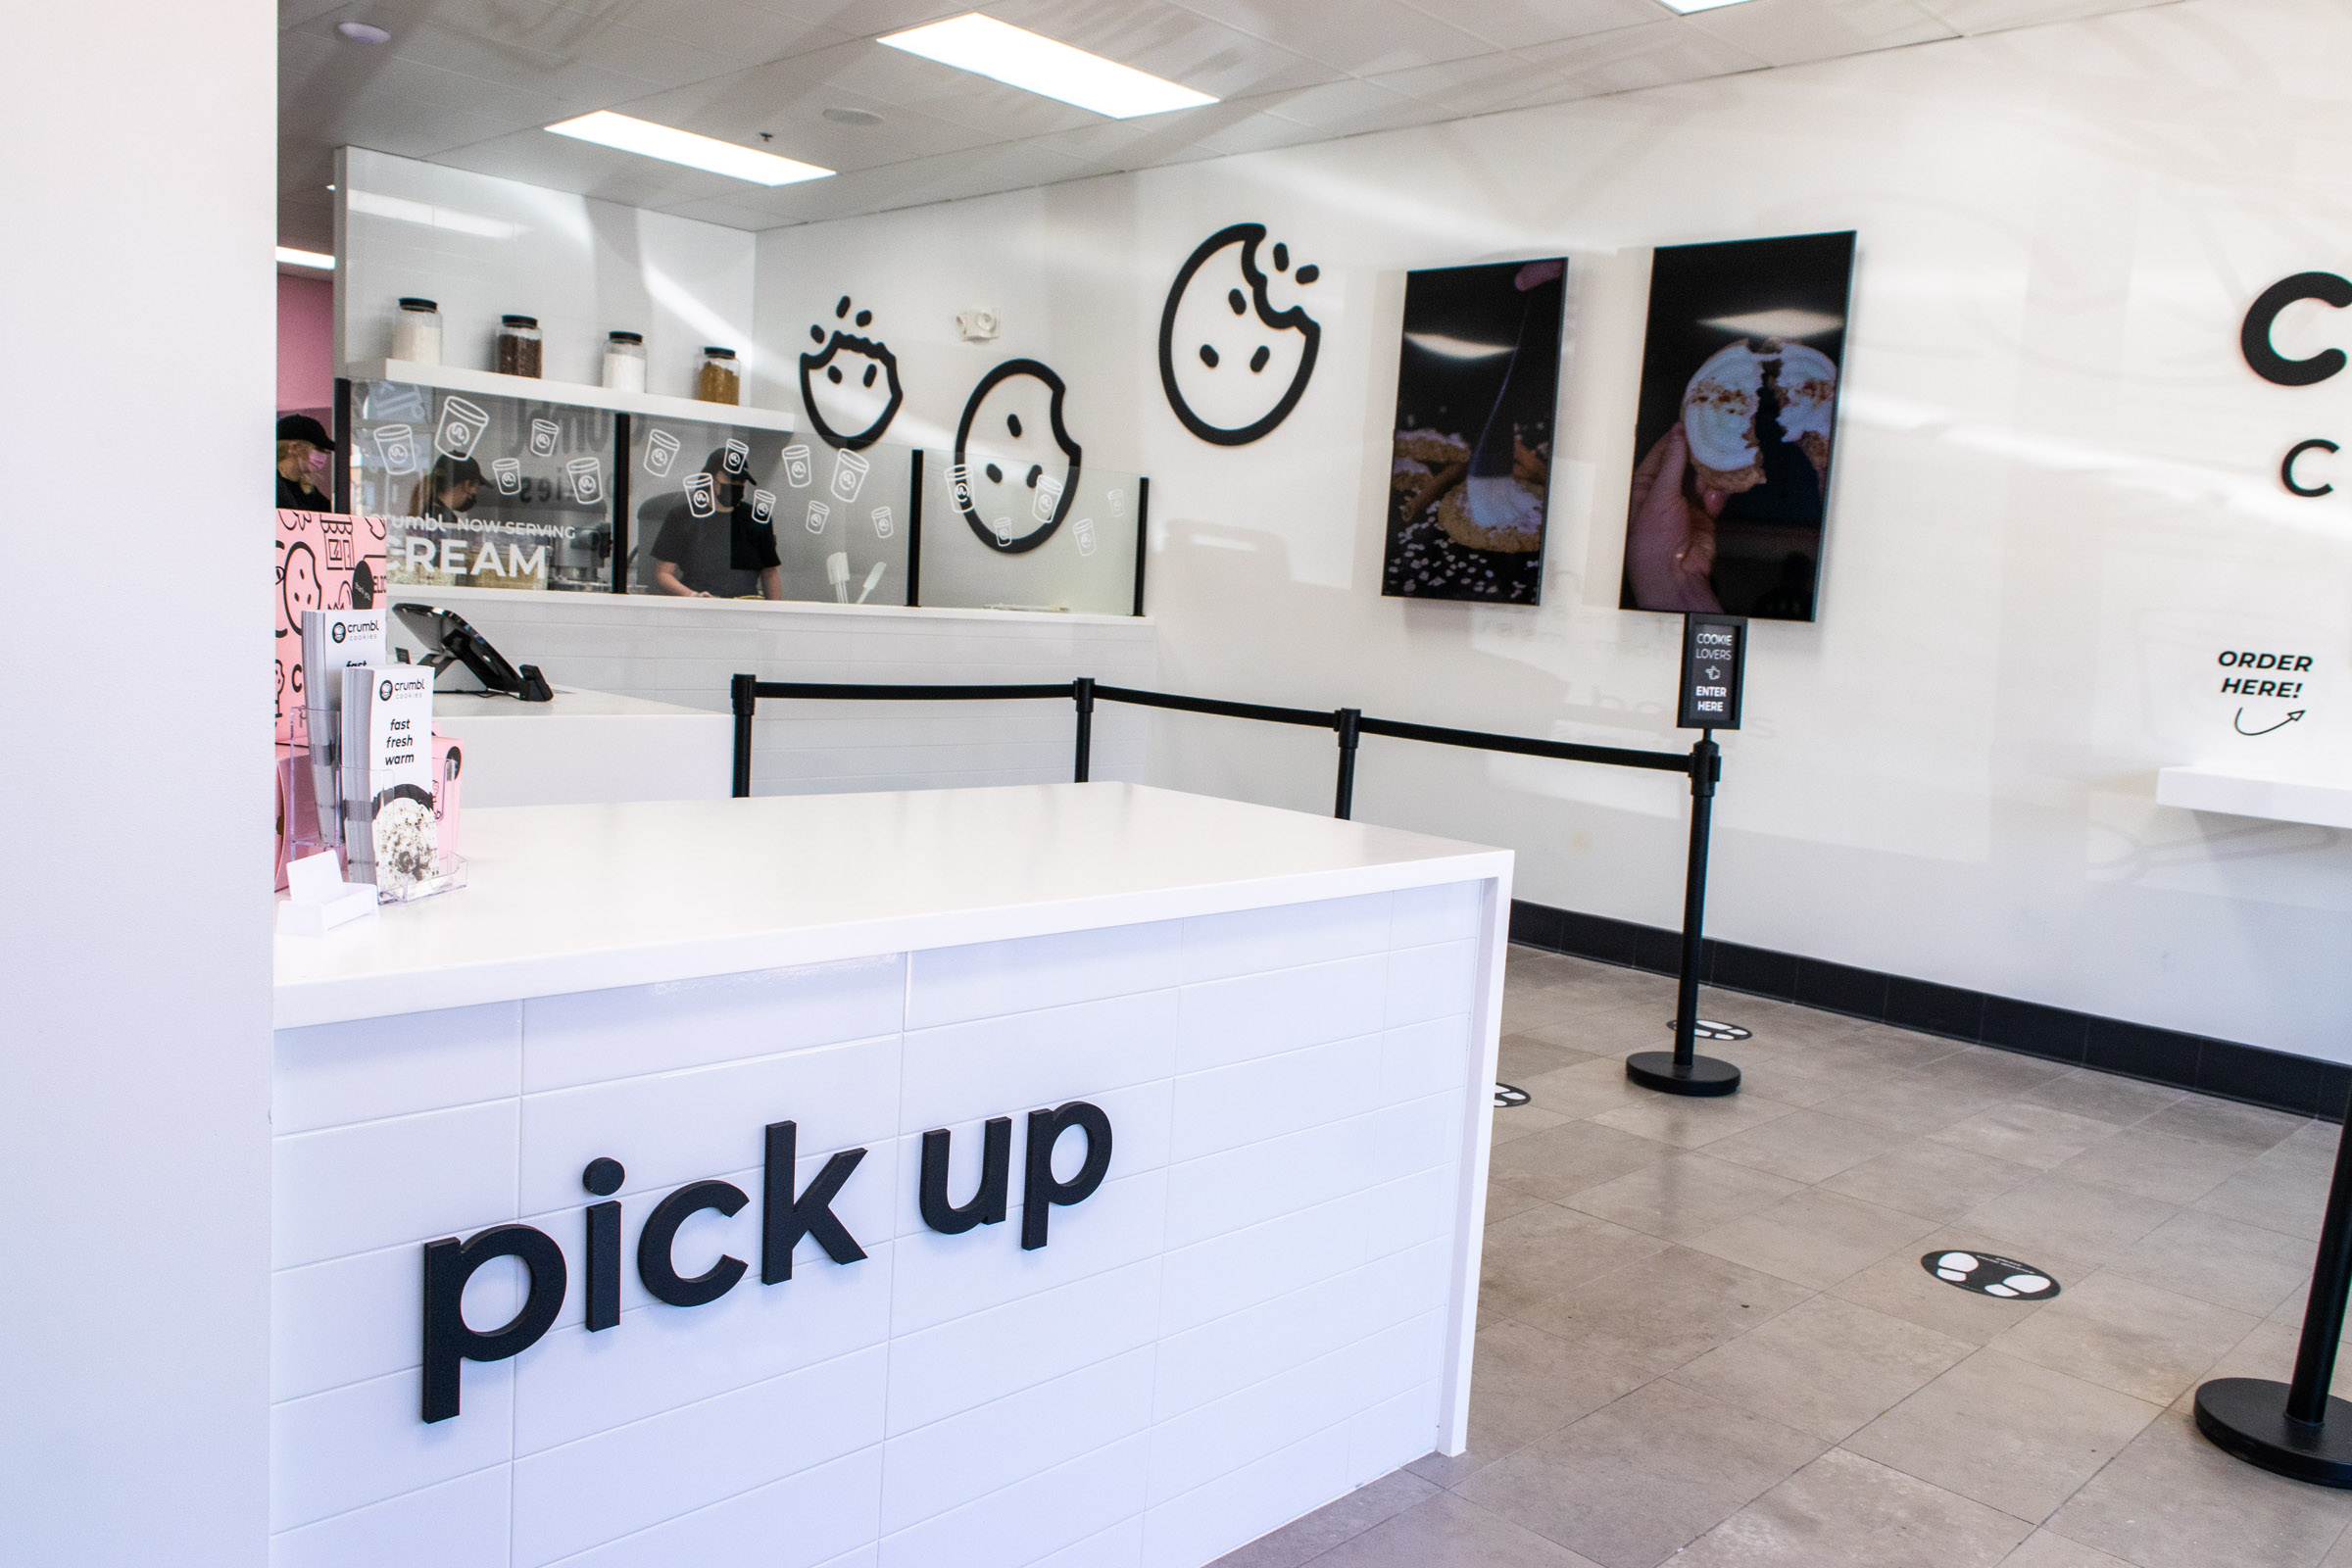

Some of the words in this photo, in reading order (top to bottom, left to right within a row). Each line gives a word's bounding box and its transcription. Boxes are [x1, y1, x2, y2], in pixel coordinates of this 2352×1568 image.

[457, 517, 501, 532] NOW
[505, 521, 576, 539] SERVING
[347, 619, 379, 633] crumbl
[1696, 633, 1733, 646] COOKIE
[1695, 649, 1732, 661] LOVERS
[2218, 651, 2314, 672] ORDER
[394, 679, 425, 692] crumbl
[1695, 686, 1727, 697] ENTER
[2221, 677, 2303, 699] HERE!
[1697, 701, 1724, 711] HERE
[390, 718, 411, 731] fast
[386, 735, 414, 749] fresh
[385, 754, 415, 765] warm
[422, 1119, 868, 1424] pick
[919, 1101, 1113, 1251] up
